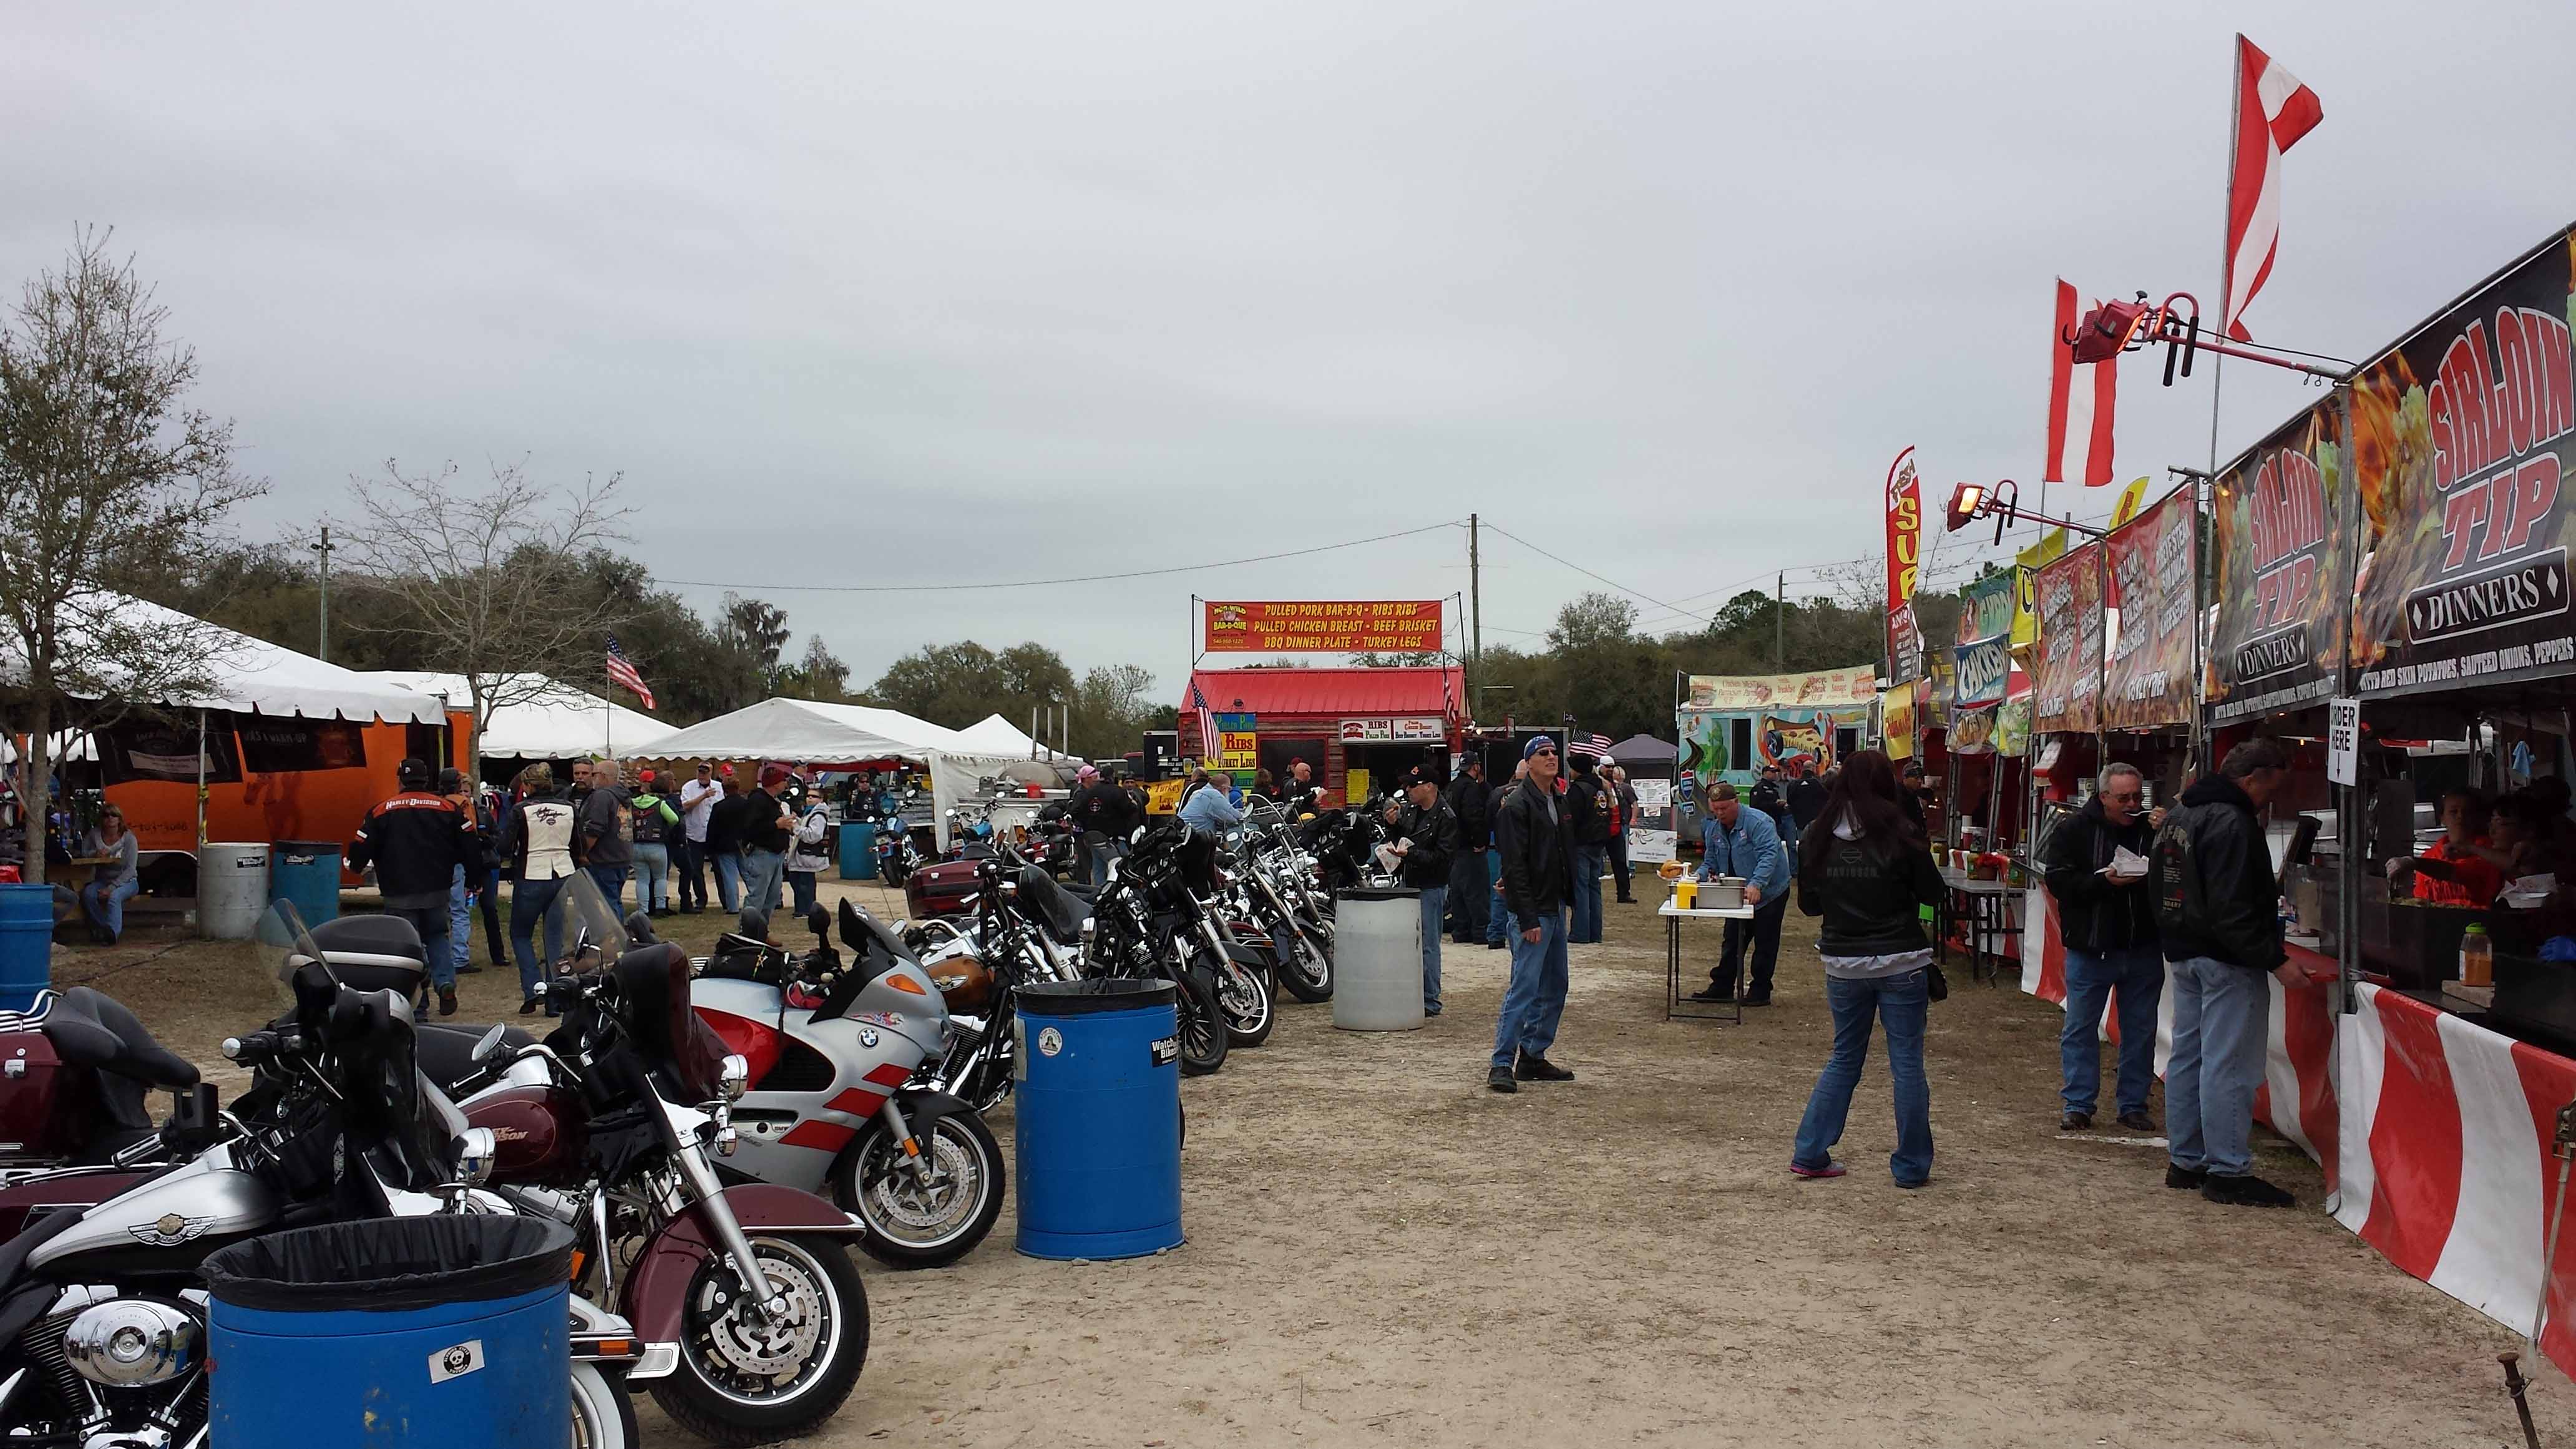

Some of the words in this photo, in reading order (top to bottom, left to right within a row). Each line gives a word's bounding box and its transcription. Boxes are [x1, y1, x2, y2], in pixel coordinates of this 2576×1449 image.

[2427, 305, 2574, 492] SIRLOIN
[2249, 447, 2324, 573] SIRLOIN
[2442, 452, 2562, 573] TIP
[2252, 554, 2316, 633] TIP
[2427, 567, 2541, 632] DINNERS
[1265, 605, 1297, 616] PULLED
[1300, 604, 1324, 617] PORK
[1372, 604, 1393, 616] RIBS
[1395, 603, 1418, 616] RIBS
[2122, 593, 2144, 630] POLISH
[1254, 620, 1286, 632] PULLED
[1289, 620, 1328, 632] CHICKEN
[1330, 620, 1364, 632] BREAST
[1373, 620, 1397, 632] BEEF
[1398, 620, 1437, 632] BRISKET
[1264, 637, 1284, 649] BBQ
[1286, 637, 1322, 648] DINNER
[1324, 636, 1352, 648] PLATE
[1363, 636, 1398, 648] TURKEY
[1400, 636, 1422, 648] LEGS
[2116, 620, 2146, 661] SAUSAGE
[2245, 635, 2296, 675] DINNERS
[2381, 670, 2396, 688] RED
[2397, 666, 2416, 686] SKIN
[2417, 658, 2459, 683] POTATOES,
[2461, 651, 2497, 677] SAUTEED
[2499, 644, 2534, 671] ONIONS,
[2534, 637, 2574, 665] PEPPERS
[1368, 721, 1388, 729] RIBS
[2331, 706, 2355, 728] ORDER
[1225, 733, 1252, 749] RIBS
[2331, 730, 2351, 751] HERE
[1240, 753, 1255, 768] LEGS
[1155, 782, 1181, 793] Turkey
[1152, 1037, 1174, 1051] Watch
